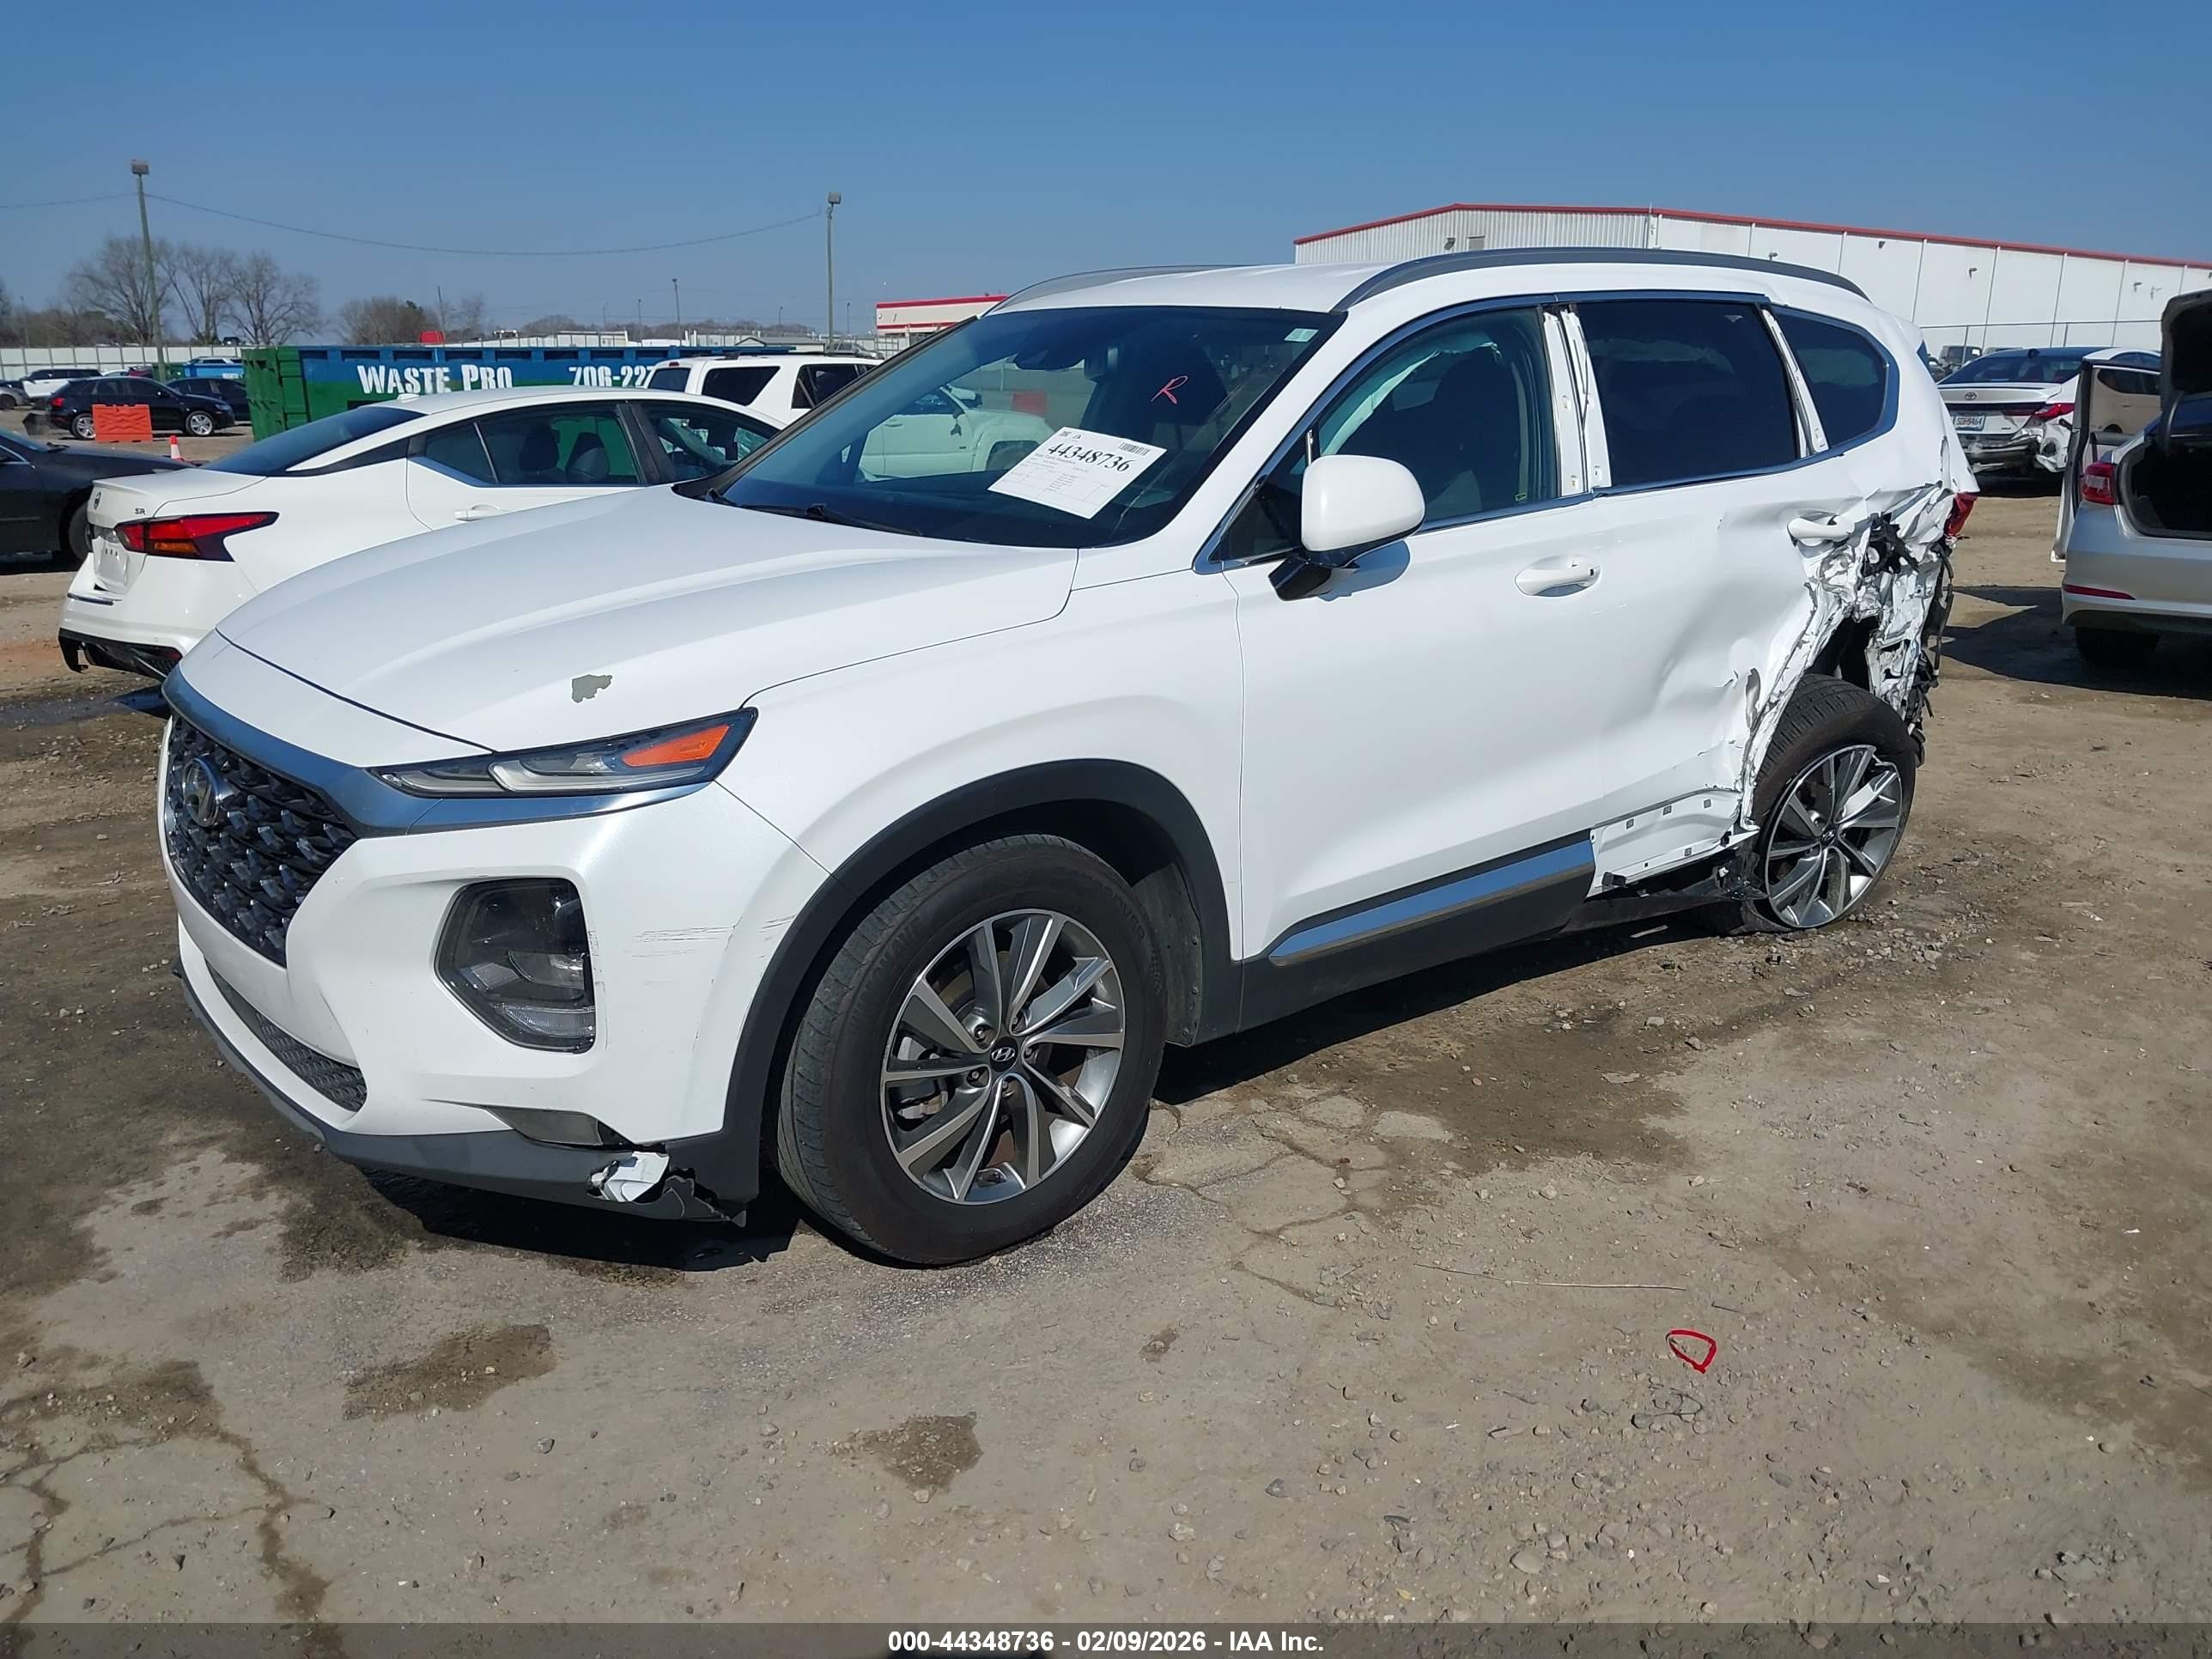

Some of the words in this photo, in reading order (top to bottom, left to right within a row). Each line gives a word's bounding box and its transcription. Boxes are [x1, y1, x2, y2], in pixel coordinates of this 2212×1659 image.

[357, 365, 452, 394] WASTE
[461, 364, 513, 392] PRO
[1048, 442, 1136, 472] 44348736
